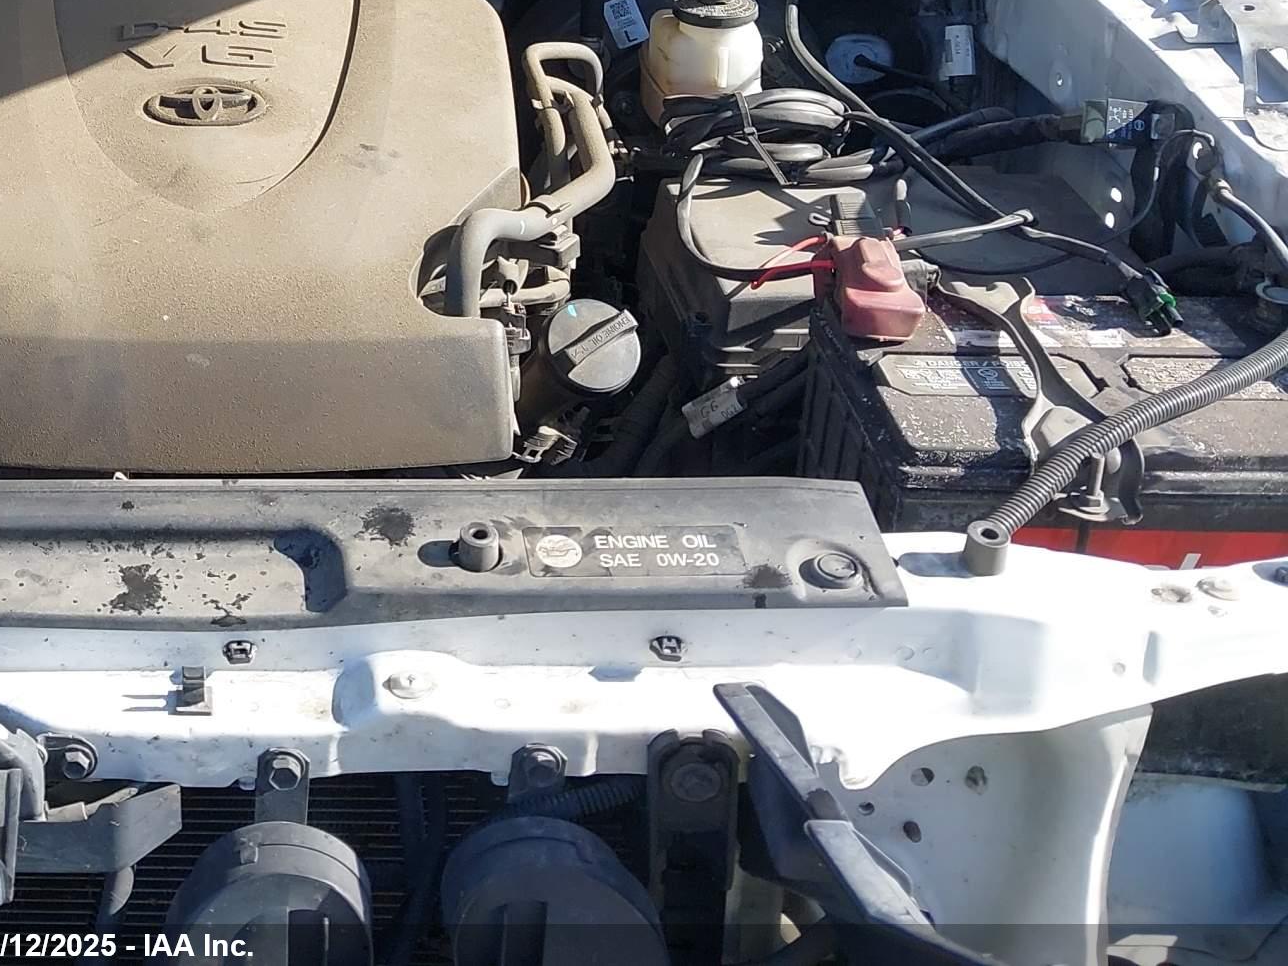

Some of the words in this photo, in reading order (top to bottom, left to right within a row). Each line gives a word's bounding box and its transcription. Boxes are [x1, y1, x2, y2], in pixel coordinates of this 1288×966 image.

[604, 315, 633, 339] ENGINE
[594, 535, 669, 549] ENGINE
[682, 534, 717, 549] OIL
[599, 553, 642, 567] SAE
[656, 552, 720, 568] 0W-20
